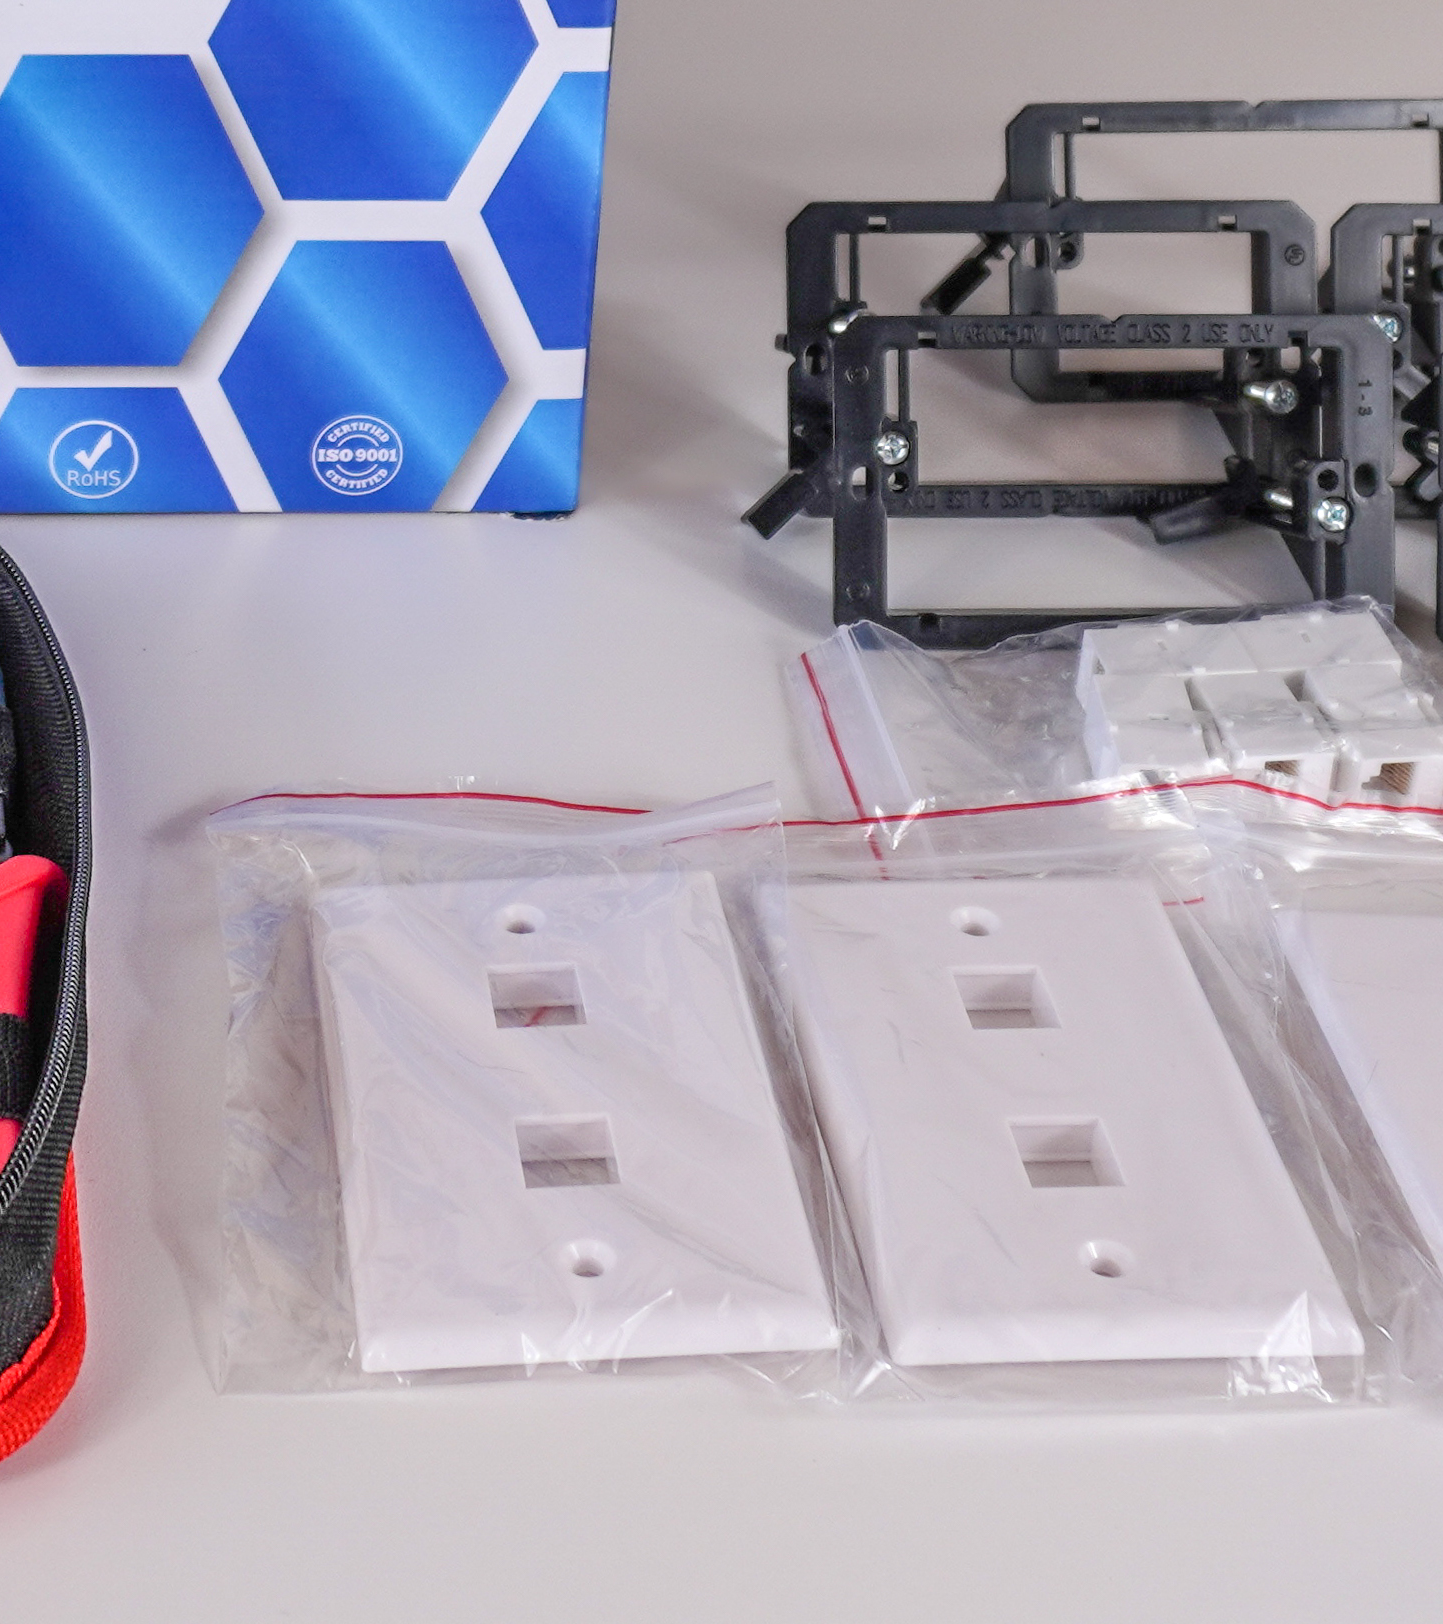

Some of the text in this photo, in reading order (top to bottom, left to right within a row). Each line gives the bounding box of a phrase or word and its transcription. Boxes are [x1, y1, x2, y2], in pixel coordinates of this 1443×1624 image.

[1127, 322, 1171, 344] CLASS
[1182, 322, 1191, 344] 2
[1202, 322, 1229, 344] USE
[1239, 322, 1275, 344] ONLY
[328, 421, 390, 444] CERTIFIED
[317, 448, 399, 463] ISO 9001
[67, 470, 121, 487] RoHS
[325, 467, 389, 489] CERTIFIED
